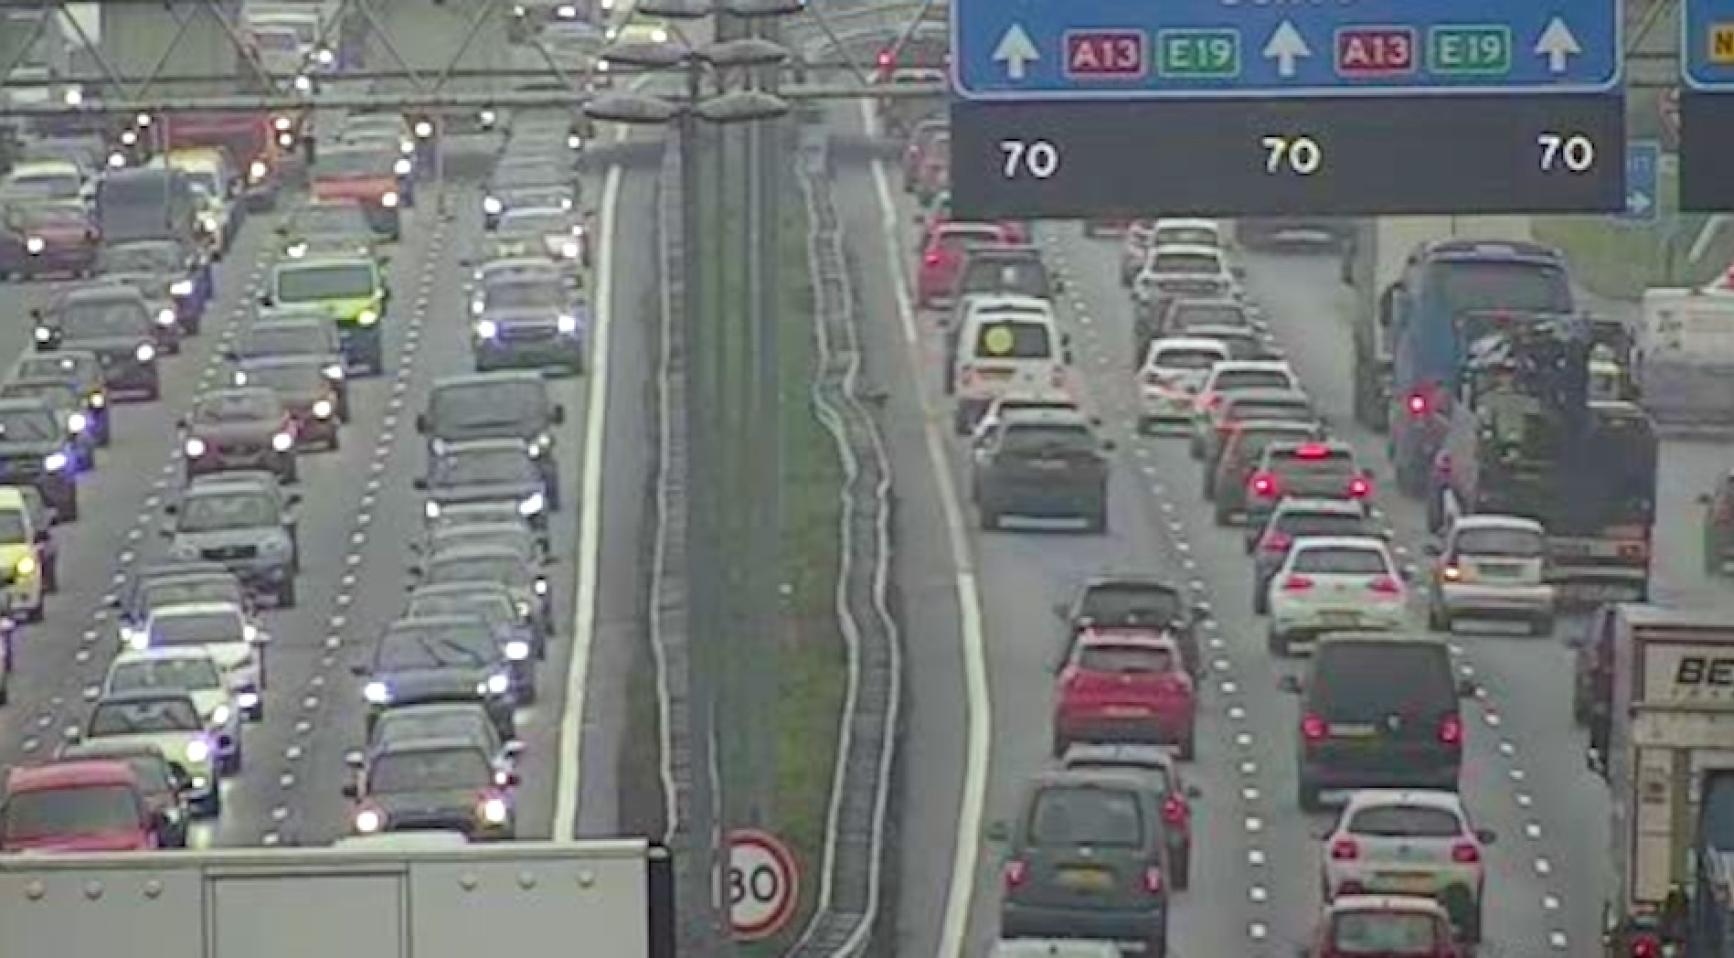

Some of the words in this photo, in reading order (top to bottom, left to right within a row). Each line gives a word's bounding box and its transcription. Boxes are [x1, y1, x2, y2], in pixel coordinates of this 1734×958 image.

[1073, 39, 1138, 67] A13
[1169, 39, 1232, 67] E19
[1344, 36, 1409, 65] A13
[1439, 35, 1500, 64] E19
[1001, 141, 1058, 178] 70
[1263, 136, 1321, 173] 70
[1538, 134, 1595, 172] 70
